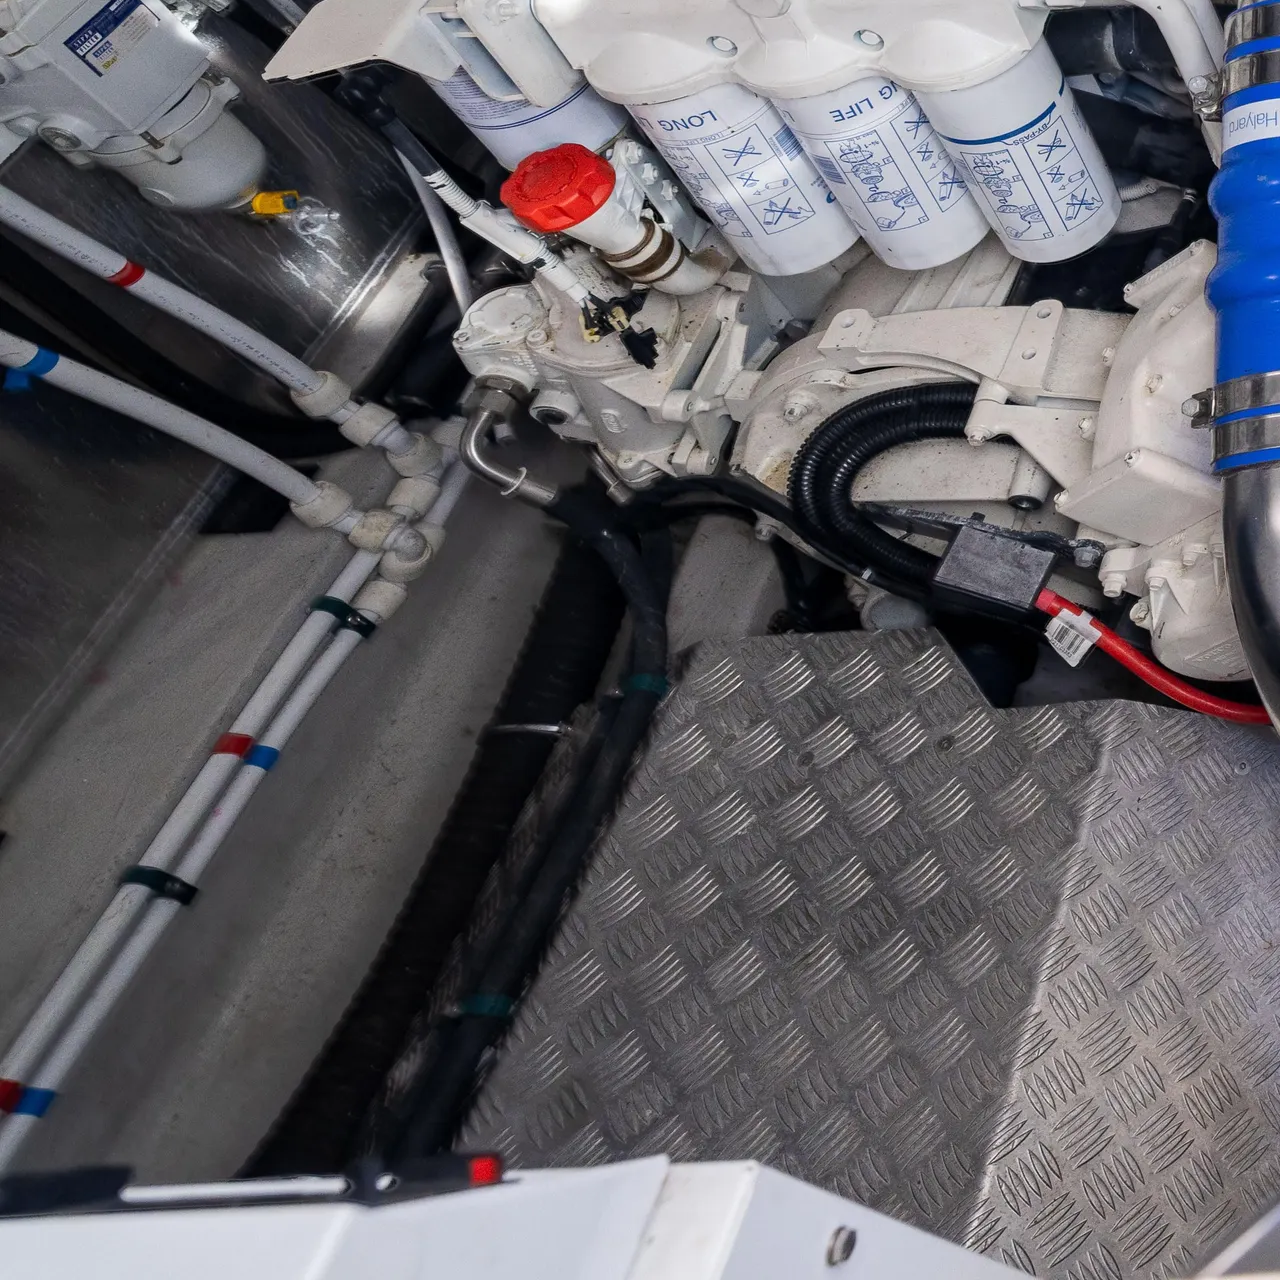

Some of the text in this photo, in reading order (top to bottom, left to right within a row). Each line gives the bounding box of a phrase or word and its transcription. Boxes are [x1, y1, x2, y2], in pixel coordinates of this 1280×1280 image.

[657, 110, 717, 132] LONG
[829, 97, 874, 122] LIFE
[1012, 122, 1048, 146] BY-PASS
[1229, 110, 1278, 137] Halyard
